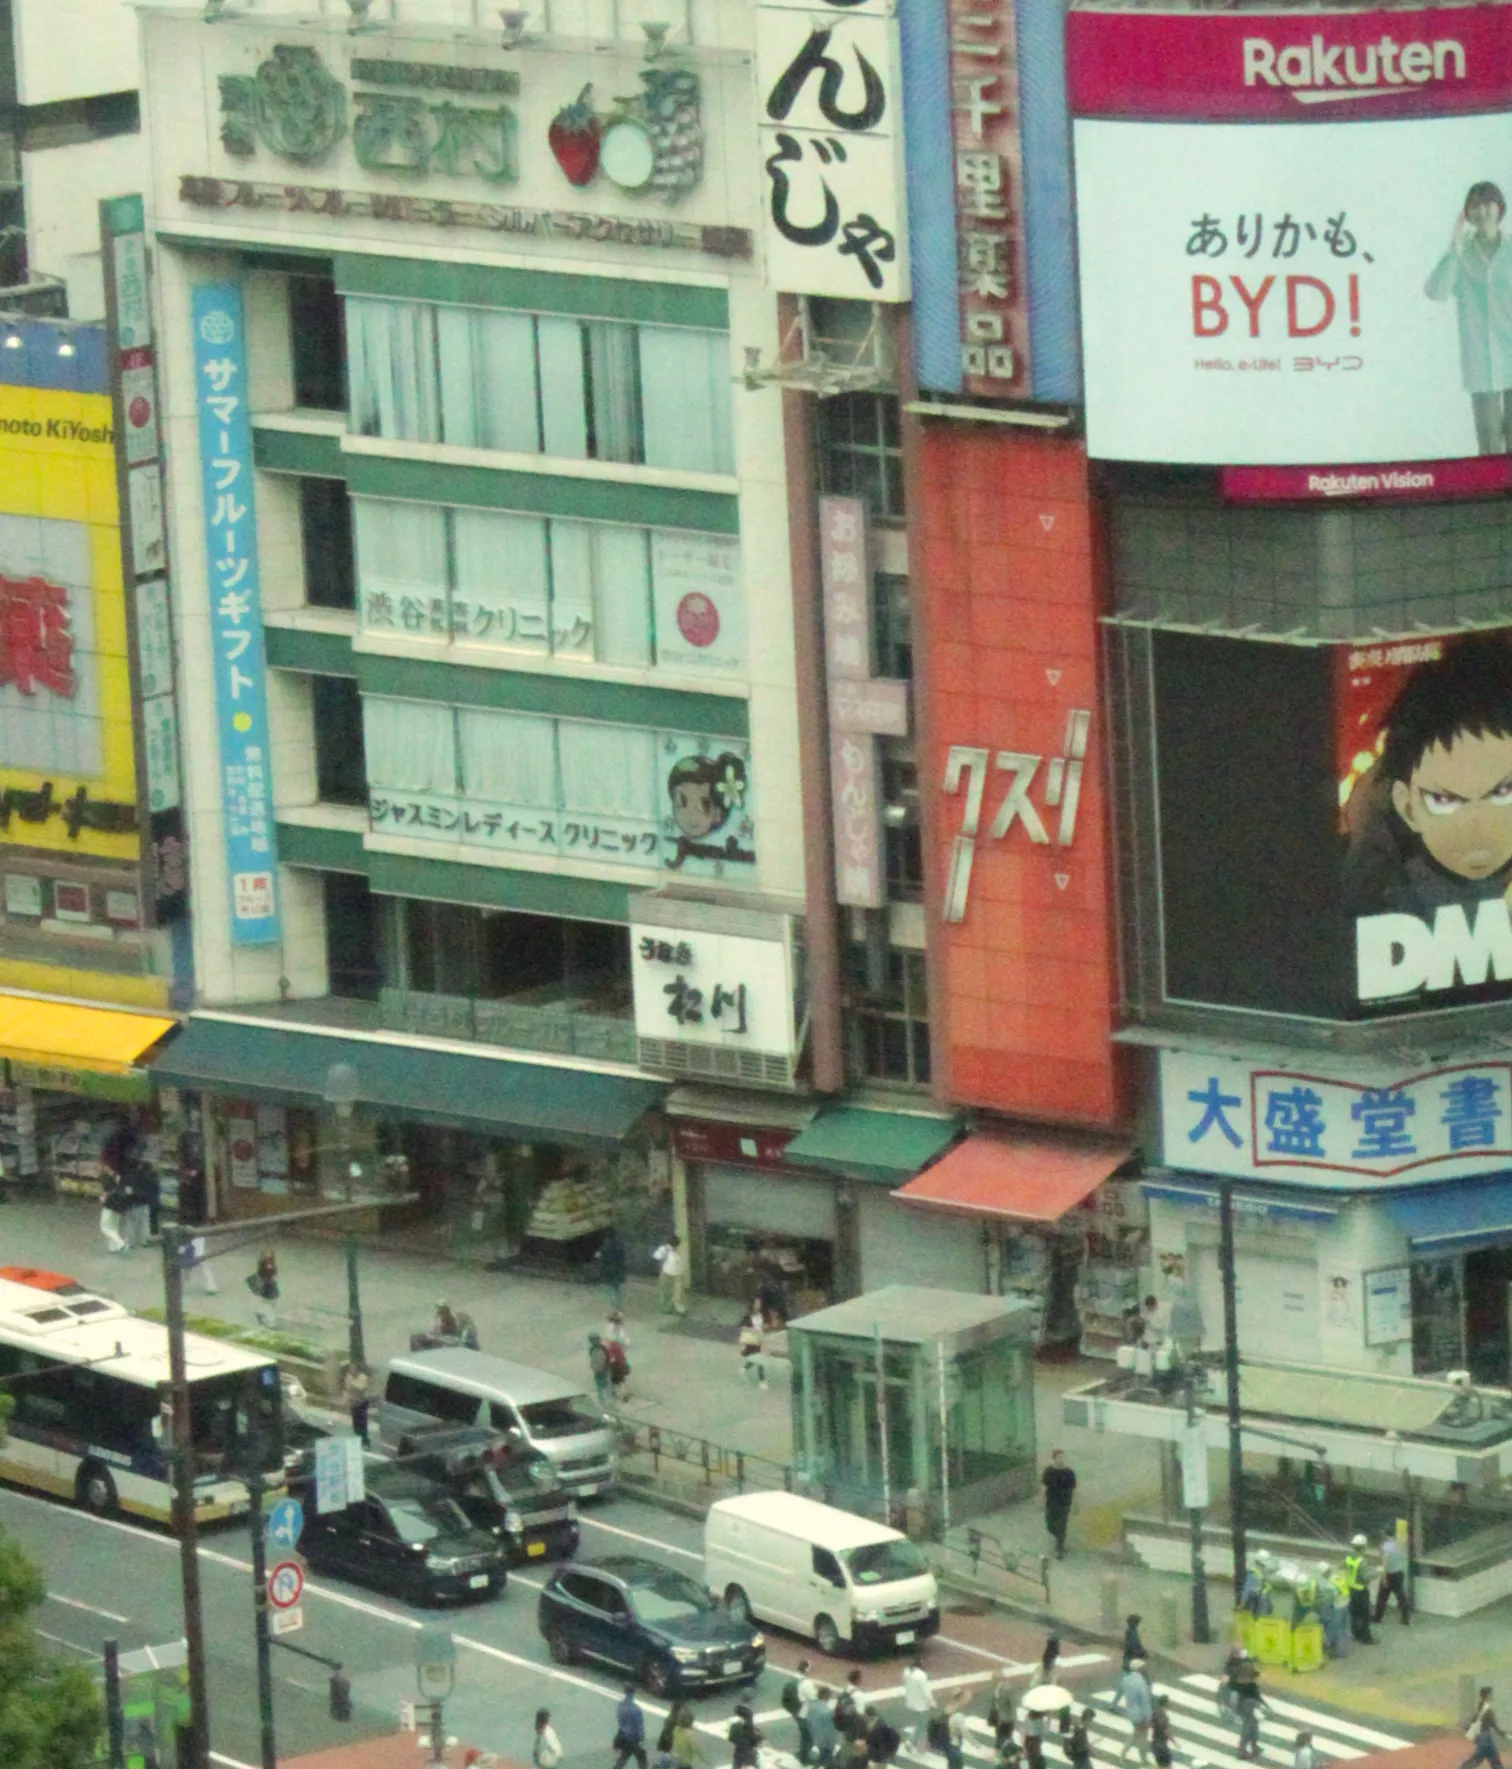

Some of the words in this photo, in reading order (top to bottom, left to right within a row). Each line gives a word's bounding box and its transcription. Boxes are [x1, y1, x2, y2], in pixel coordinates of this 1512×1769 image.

[1243, 35, 1466, 88] Rakuten
[766, 0, 896, 290] んじゃ
[1184, 208, 1377, 264] ありかも、
[1191, 272, 1363, 338] BYD!
[1308, 473, 1379, 491] Rakuten
[1382, 471, 1434, 488] Vision
[202, 356, 254, 700] サマーフルーツギフト
[944, 709, 1092, 924] クスリ
